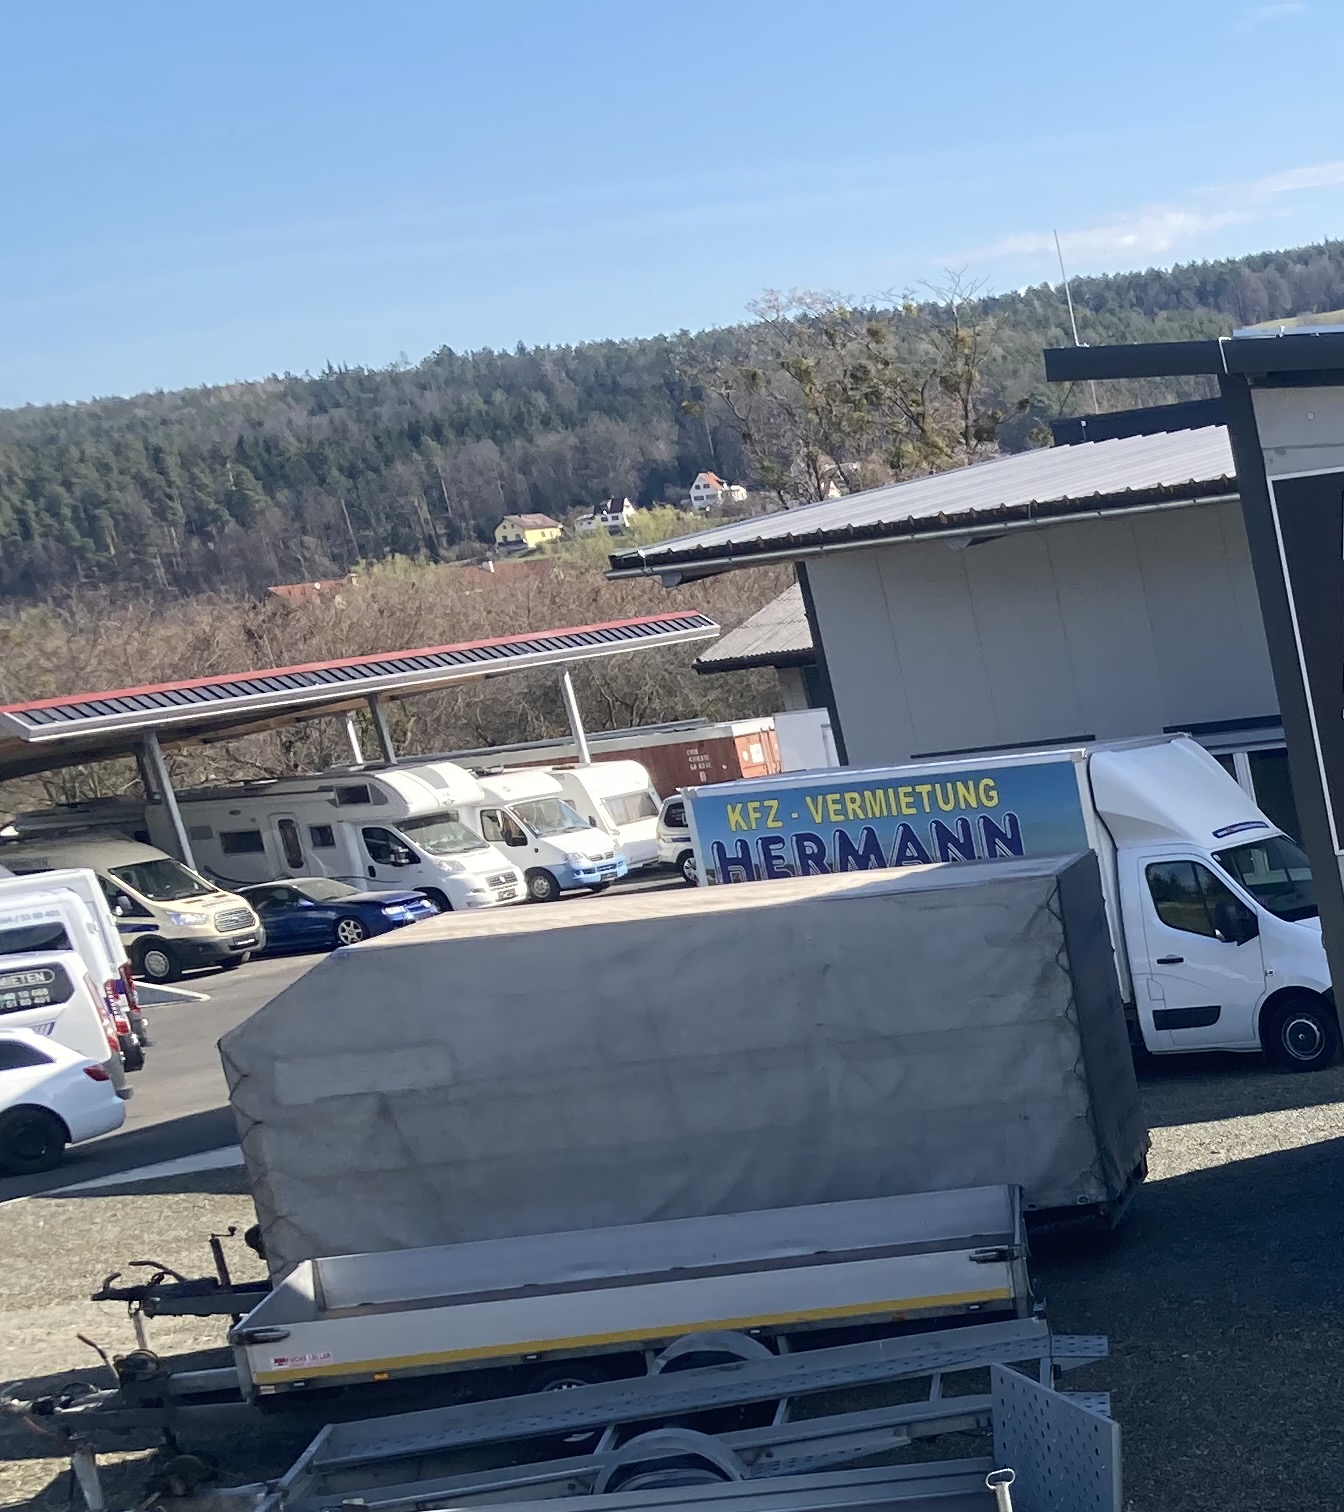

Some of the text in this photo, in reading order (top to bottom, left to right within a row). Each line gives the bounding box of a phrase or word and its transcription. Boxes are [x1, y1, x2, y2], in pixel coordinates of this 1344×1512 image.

[727, 800, 783, 832] KFZ
[805, 777, 1000, 824] VERMIETUNG
[710, 811, 1026, 885] HERMANN
